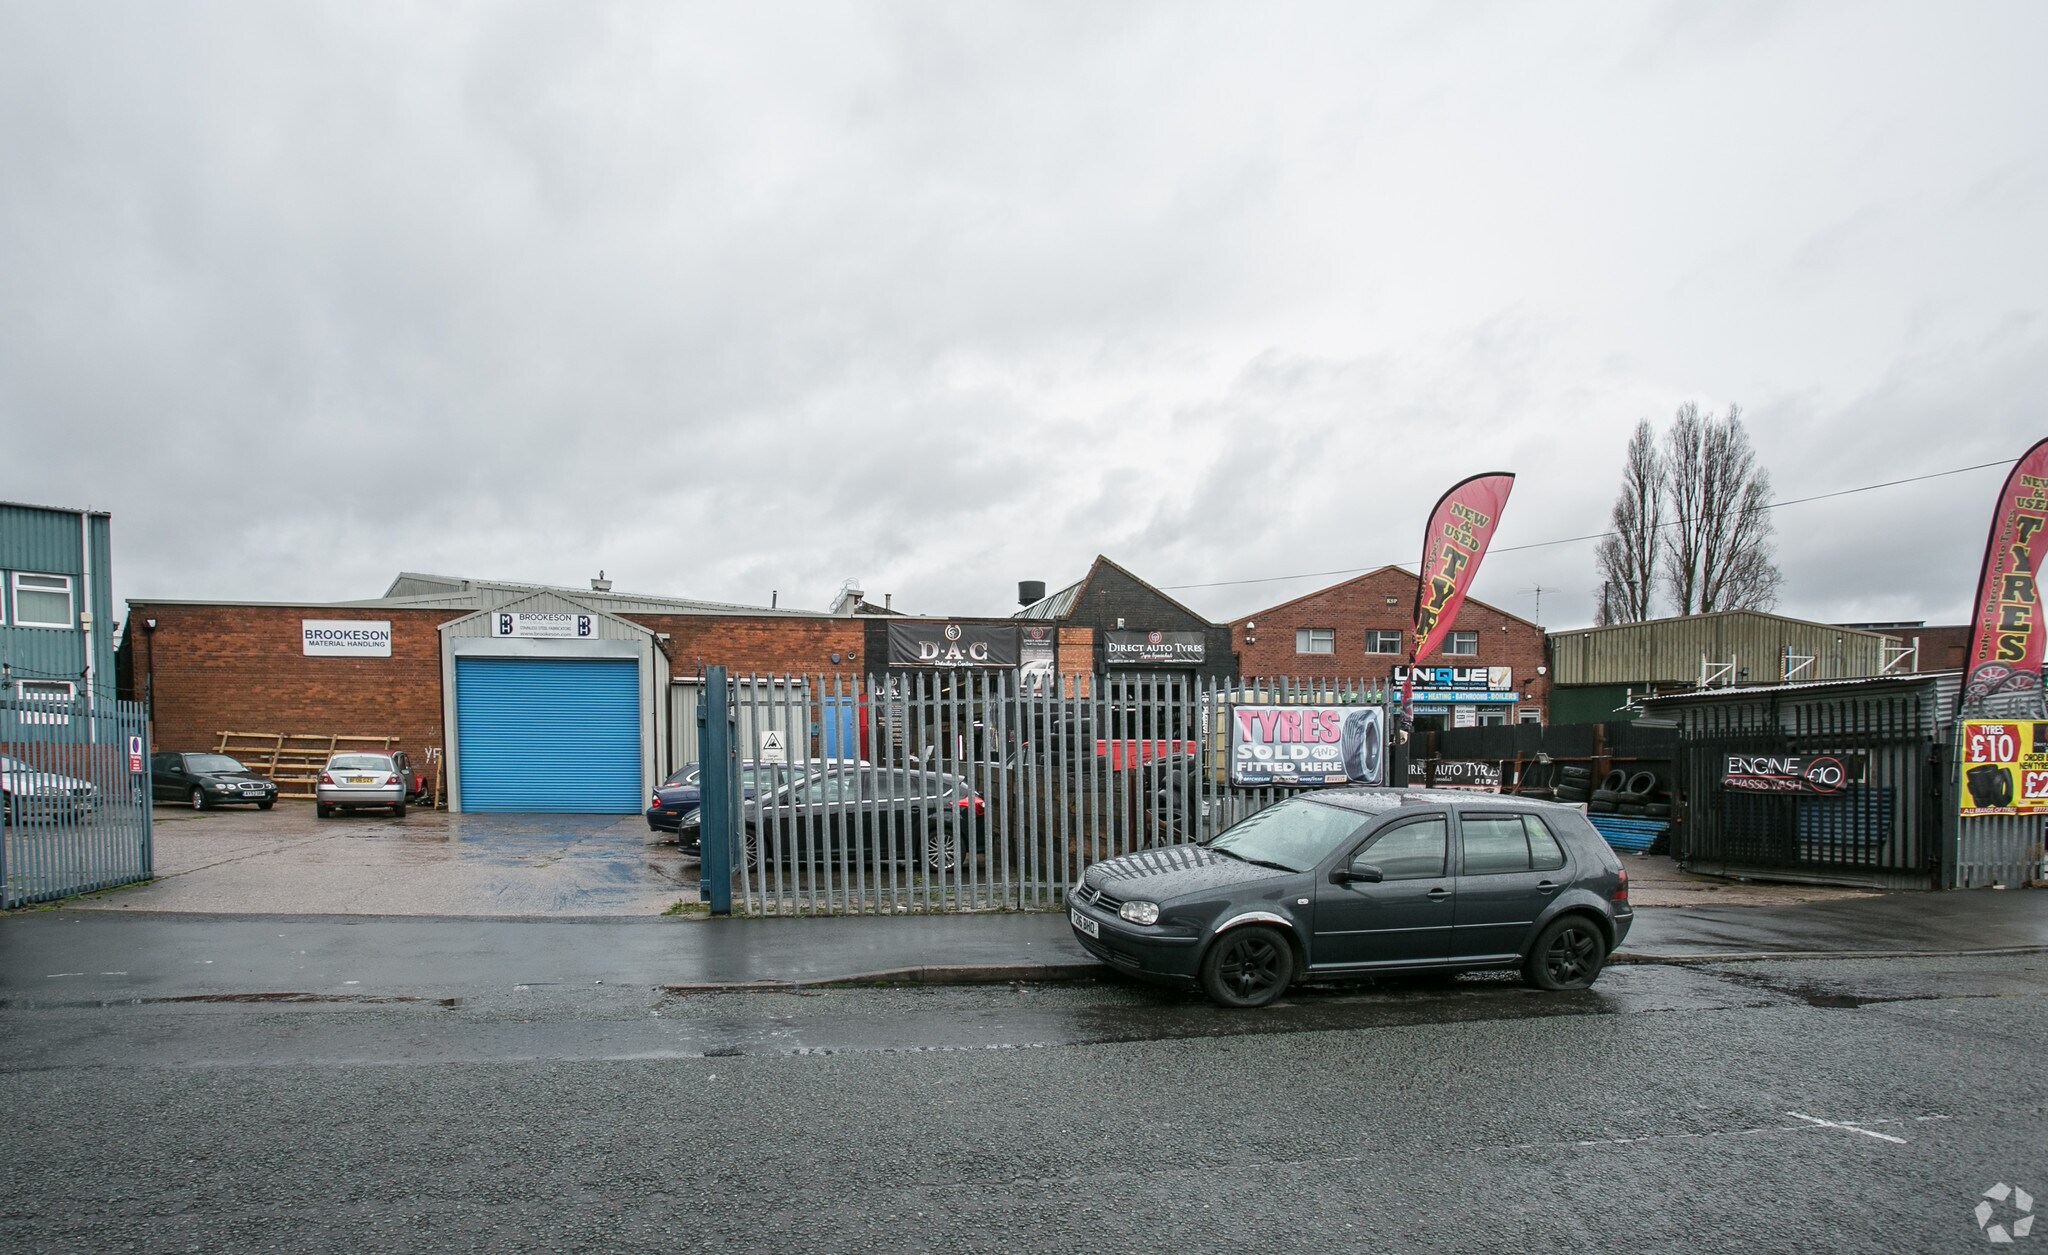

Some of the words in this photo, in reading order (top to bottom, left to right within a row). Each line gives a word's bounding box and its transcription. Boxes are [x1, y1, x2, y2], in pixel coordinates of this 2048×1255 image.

[1450, 501, 1490, 528] NEW
[1459, 520, 1472, 534] &
[1443, 523, 1480, 552] USED
[1985, 575, 2000, 614] Direct
[519, 613, 572, 622] BROOKESON
[305, 629, 389, 641] BROOKESON
[1108, 643, 1145, 653] DIRECT
[1146, 644, 1173, 652] AUTO
[1174, 643, 1203, 653] TYRES
[1490, 692, 1517, 701] BOILERS
[1236, 710, 1342, 743] TYRES
[1981, 725, 2004, 735] TYRES
[1237, 745, 1310, 760] SOLD
[1312, 746, 1338, 757] AND
[1971, 734, 2014, 762] £10
[1237, 762, 1296, 772] FITTED
[1300, 762, 1342, 772] HERE
[1435, 764, 1462, 775] AUTO
[1728, 757, 1800, 775] ENGINE
[1807, 767, 1841, 784] £10
[1724, 779, 1769, 790] CHASSIS
[1772, 780, 1802, 790] WASH
